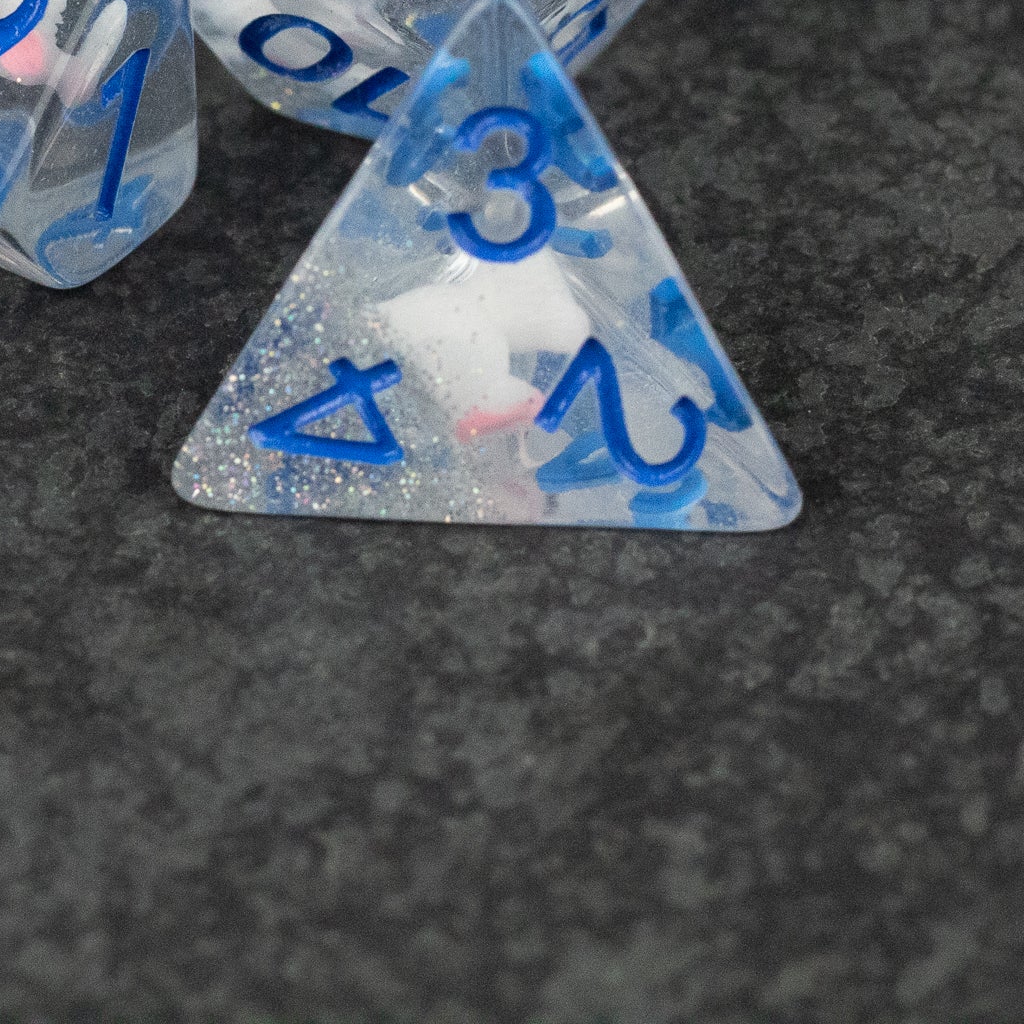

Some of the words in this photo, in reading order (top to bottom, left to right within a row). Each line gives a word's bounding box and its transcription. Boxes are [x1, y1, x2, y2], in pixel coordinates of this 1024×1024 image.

[102, 48, 152, 221] 1
[447, 106, 556, 263] 3
[248, 357, 404, 465] 4
[535, 338, 708, 486] 2
